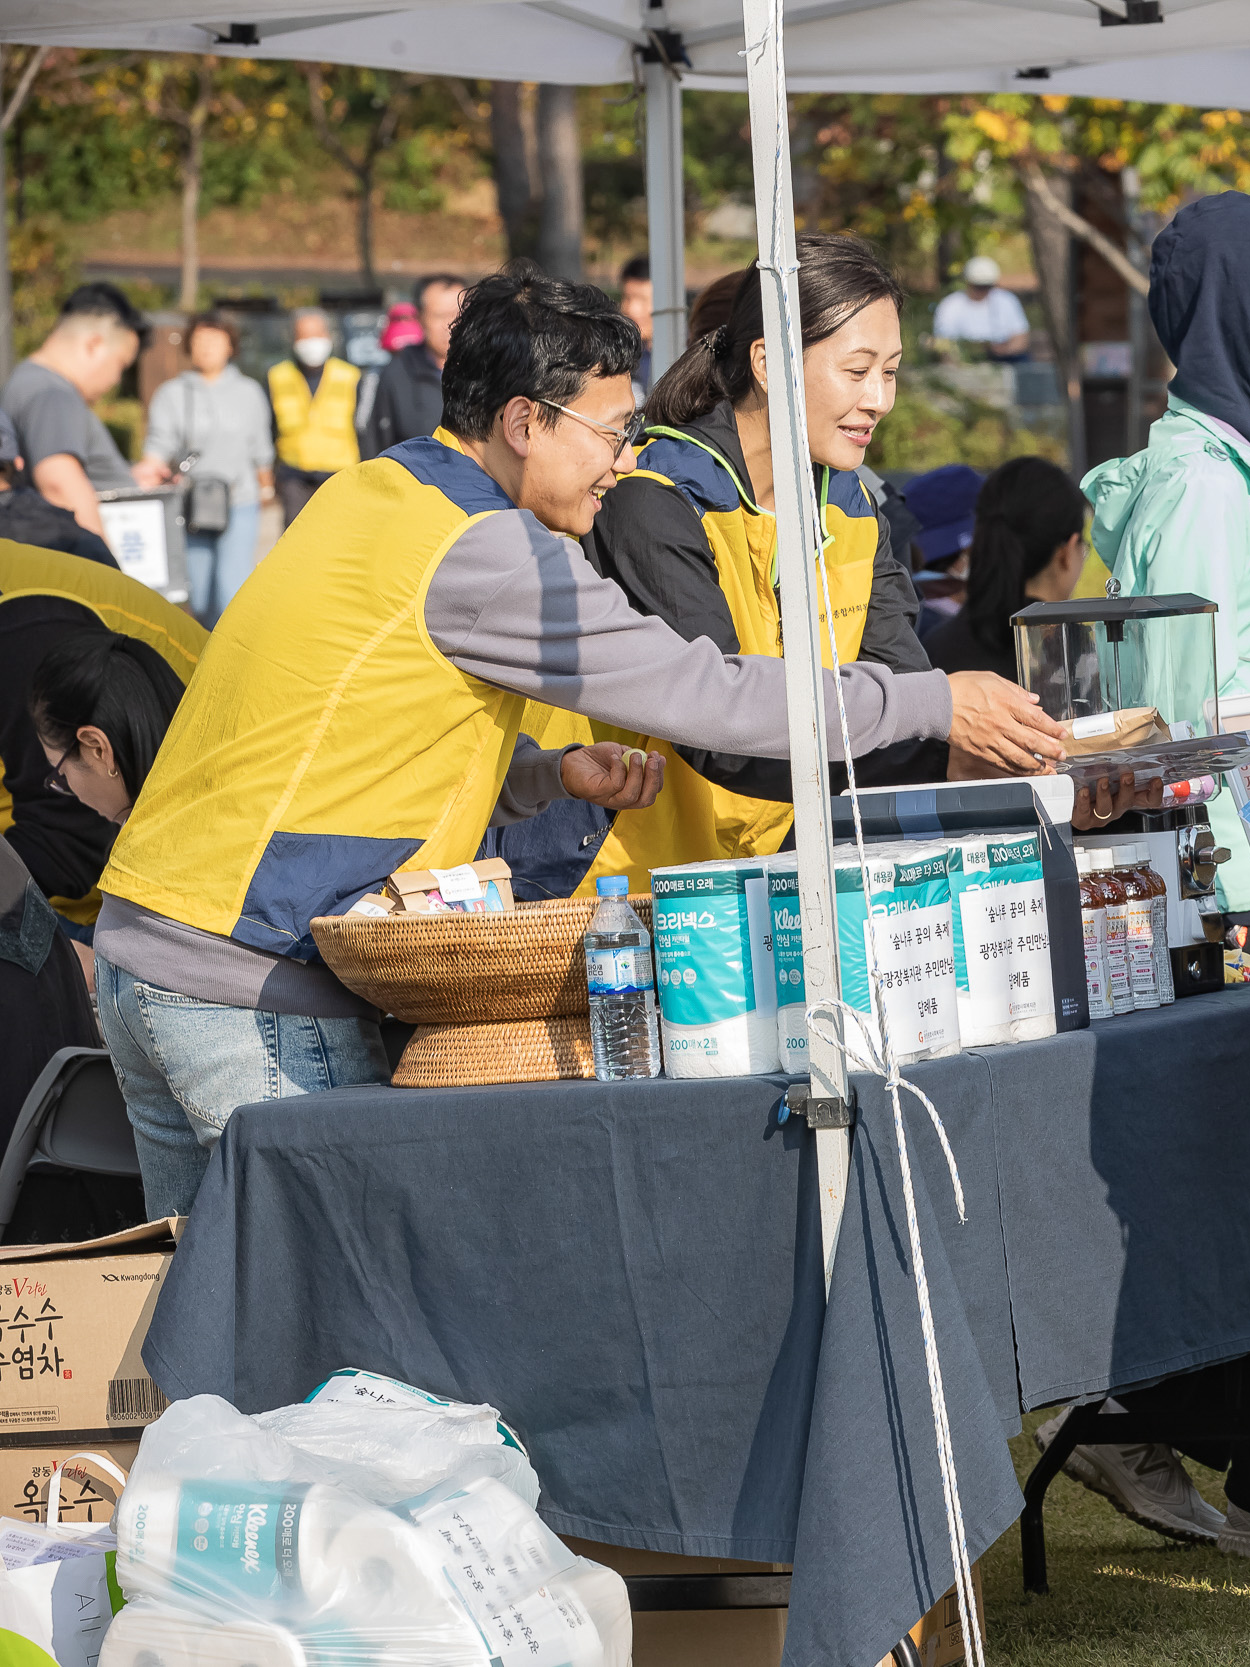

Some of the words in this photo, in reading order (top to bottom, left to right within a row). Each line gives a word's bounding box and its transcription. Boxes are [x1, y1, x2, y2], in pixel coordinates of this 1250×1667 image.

[967, 851, 986, 864] 대용량
[874, 871, 893, 884] 대용량
[924, 863, 931, 877] 더
[932, 860, 945, 874] 오래
[655, 879, 685, 893] 200매로
[686, 879, 695, 892] 더
[696, 877, 714, 890] 오래
[1009, 900, 1026, 918] 꿈의
[657, 911, 717, 931] 크리넥스
[774, 907, 801, 931] Klee
[658, 934, 672, 948] 안심
[776, 934, 790, 947] 안심
[915, 925, 931, 944] 꿈의
[979, 938, 1013, 960] 광장복지관
[883, 964, 922, 988] 광장복지관
[925, 956, 955, 979] 주민만남
[1009, 971, 1030, 990] 답례품
[917, 997, 938, 1018] 답례품
[121, 1273, 160, 1282] Kwangdong
[31, 1466, 51, 1478] 광동
[230, 1503, 246, 1524] 안심
[281, 1503, 297, 1546] 200매로
[240, 1503, 269, 1574] Kleenex
[281, 1548, 293, 1558] 더
